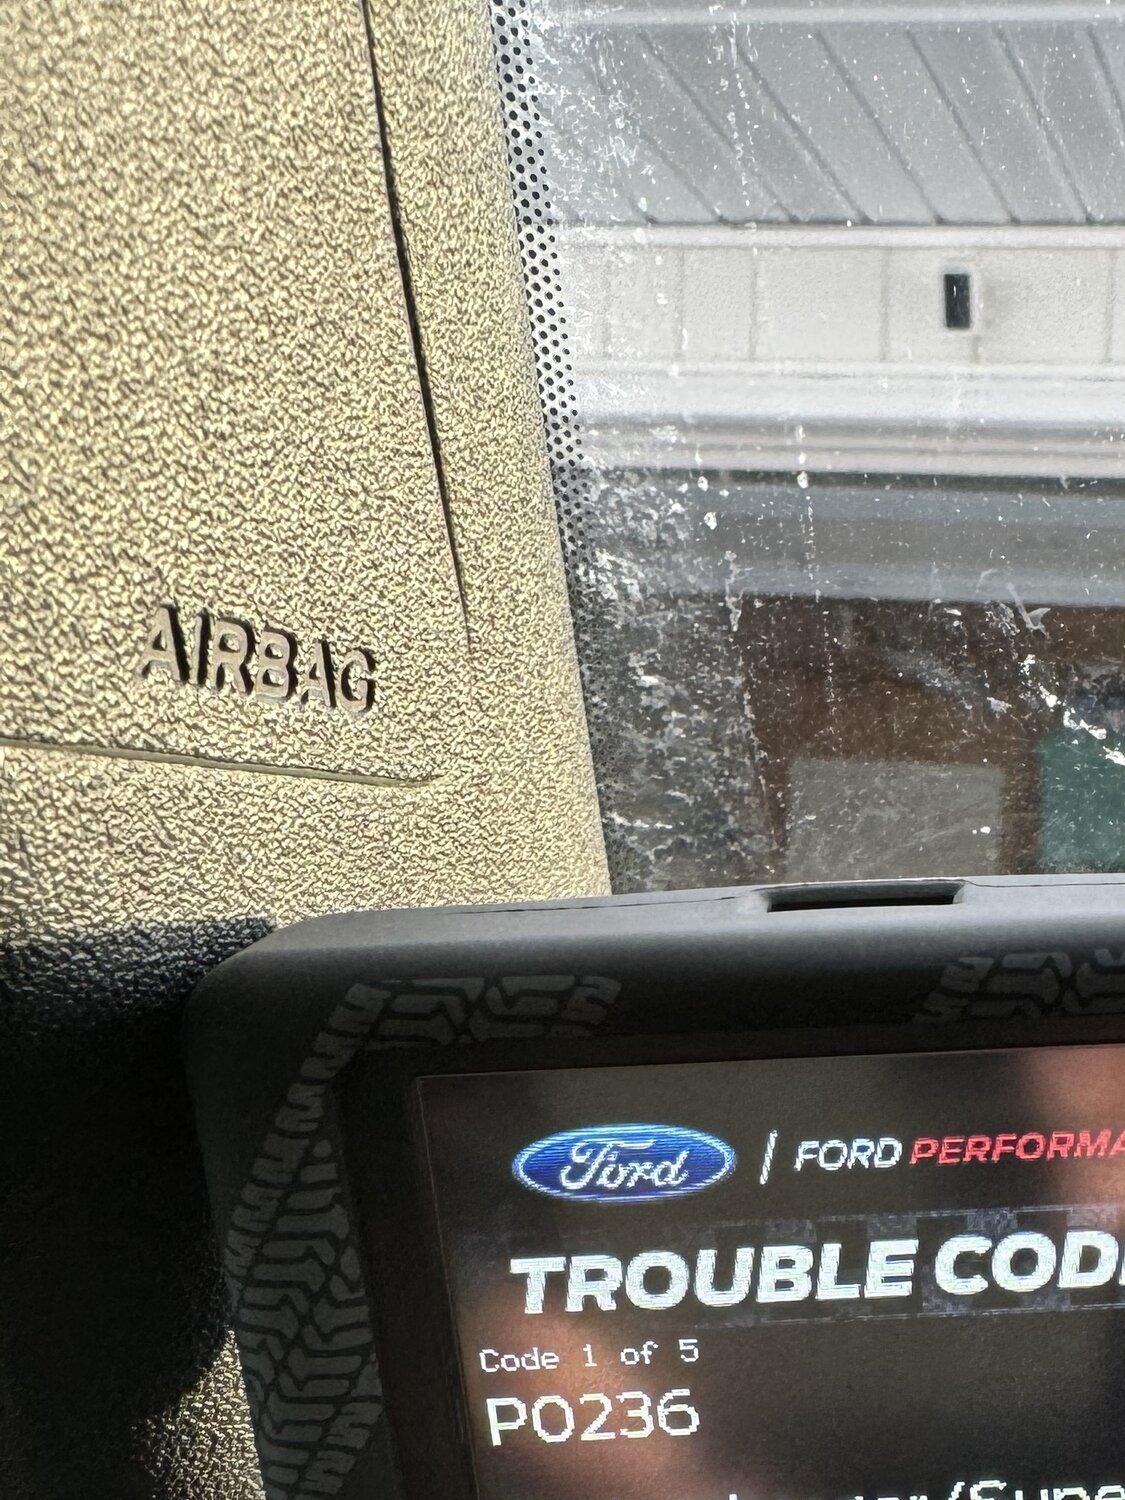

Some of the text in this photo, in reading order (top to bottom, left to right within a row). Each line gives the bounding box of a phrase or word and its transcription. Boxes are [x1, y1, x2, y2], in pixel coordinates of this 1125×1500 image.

[141, 603, 376, 713] AIRBAG
[559, 1138, 688, 1191] Ford
[794, 1137, 903, 1172] FORD
[510, 1238, 918, 1316] TROUBLE
[479, 1337, 700, 1373] Code 1 of 5
[487, 1389, 701, 1446] P0236
